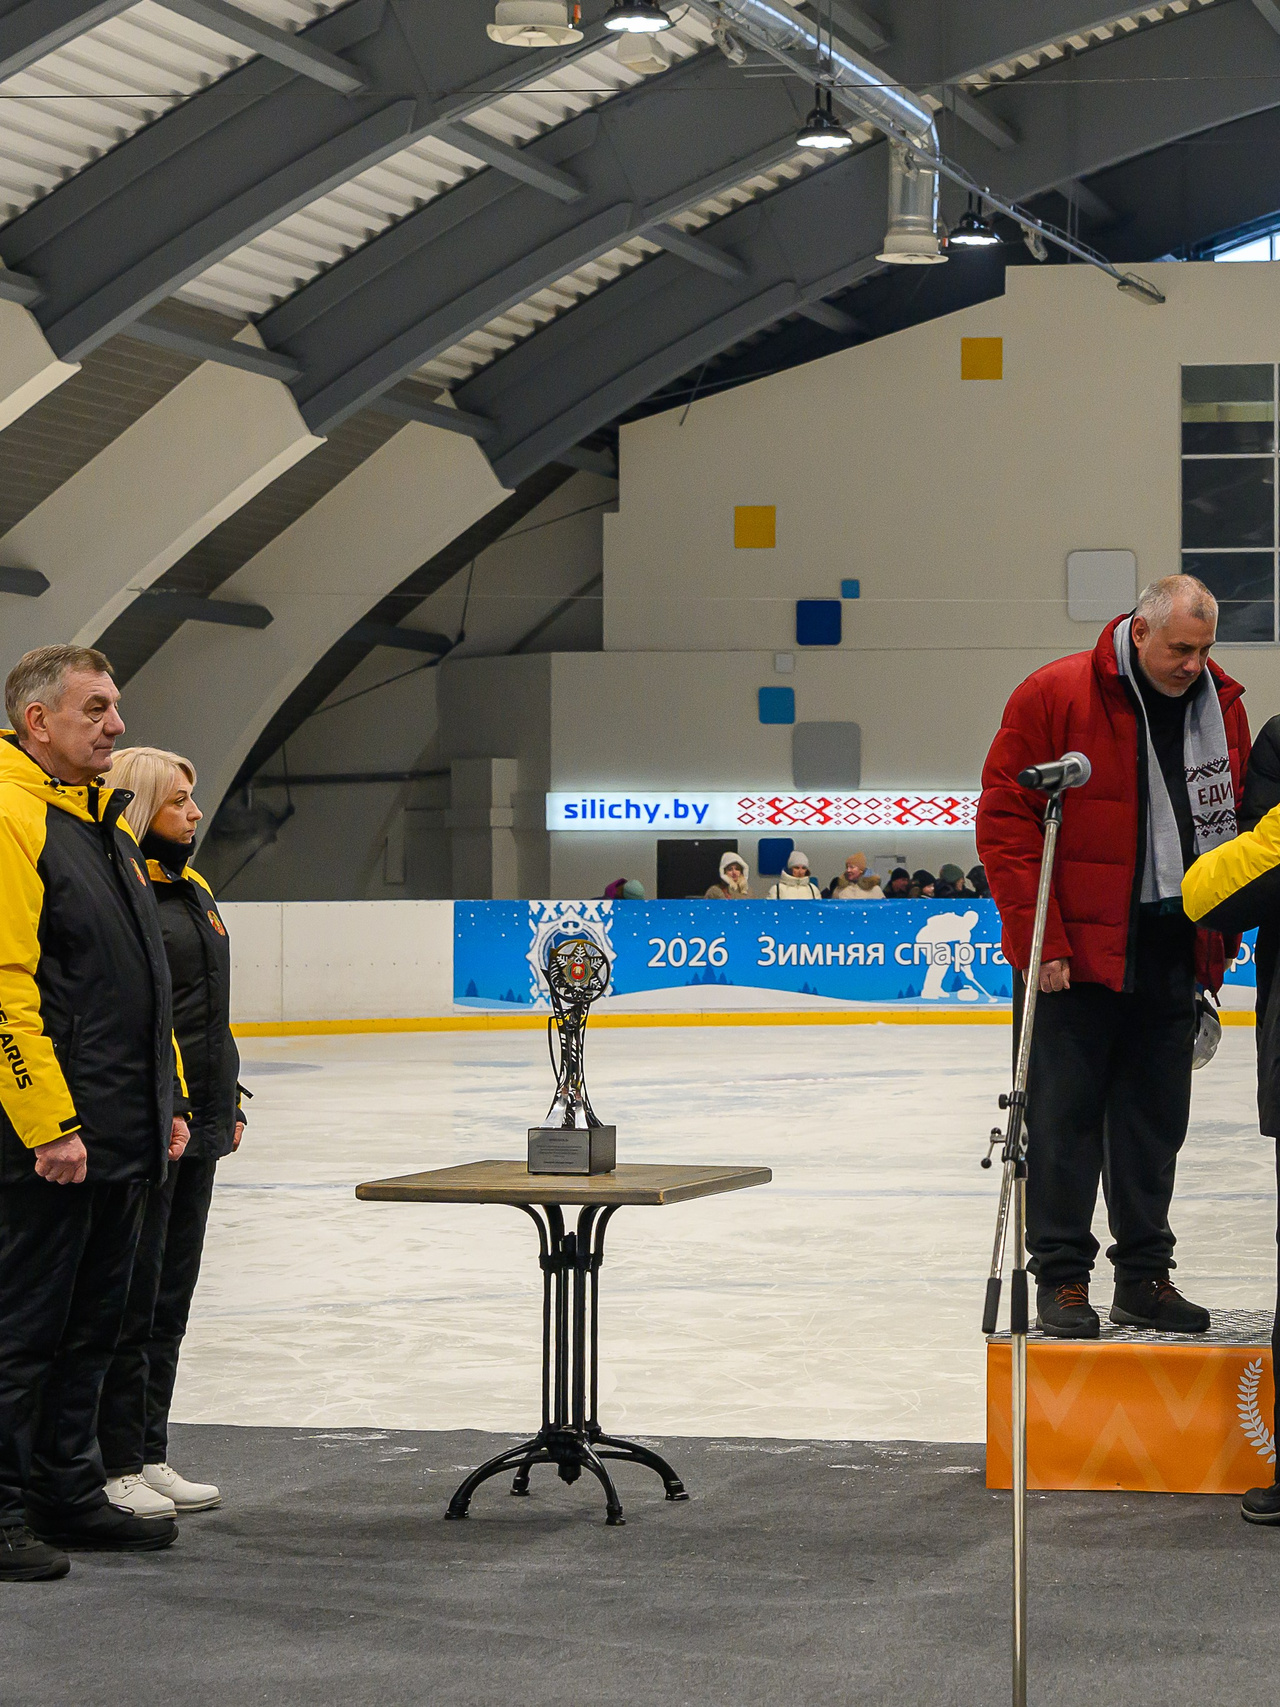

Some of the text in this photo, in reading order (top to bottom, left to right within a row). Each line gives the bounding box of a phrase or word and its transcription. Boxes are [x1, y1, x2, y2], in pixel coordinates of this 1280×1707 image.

[1197, 781, 1233, 807] ЕДИ
[564, 799, 710, 824] silichy.by
[648, 937, 729, 968] 2026
[757, 935, 885, 967] Зимняя
